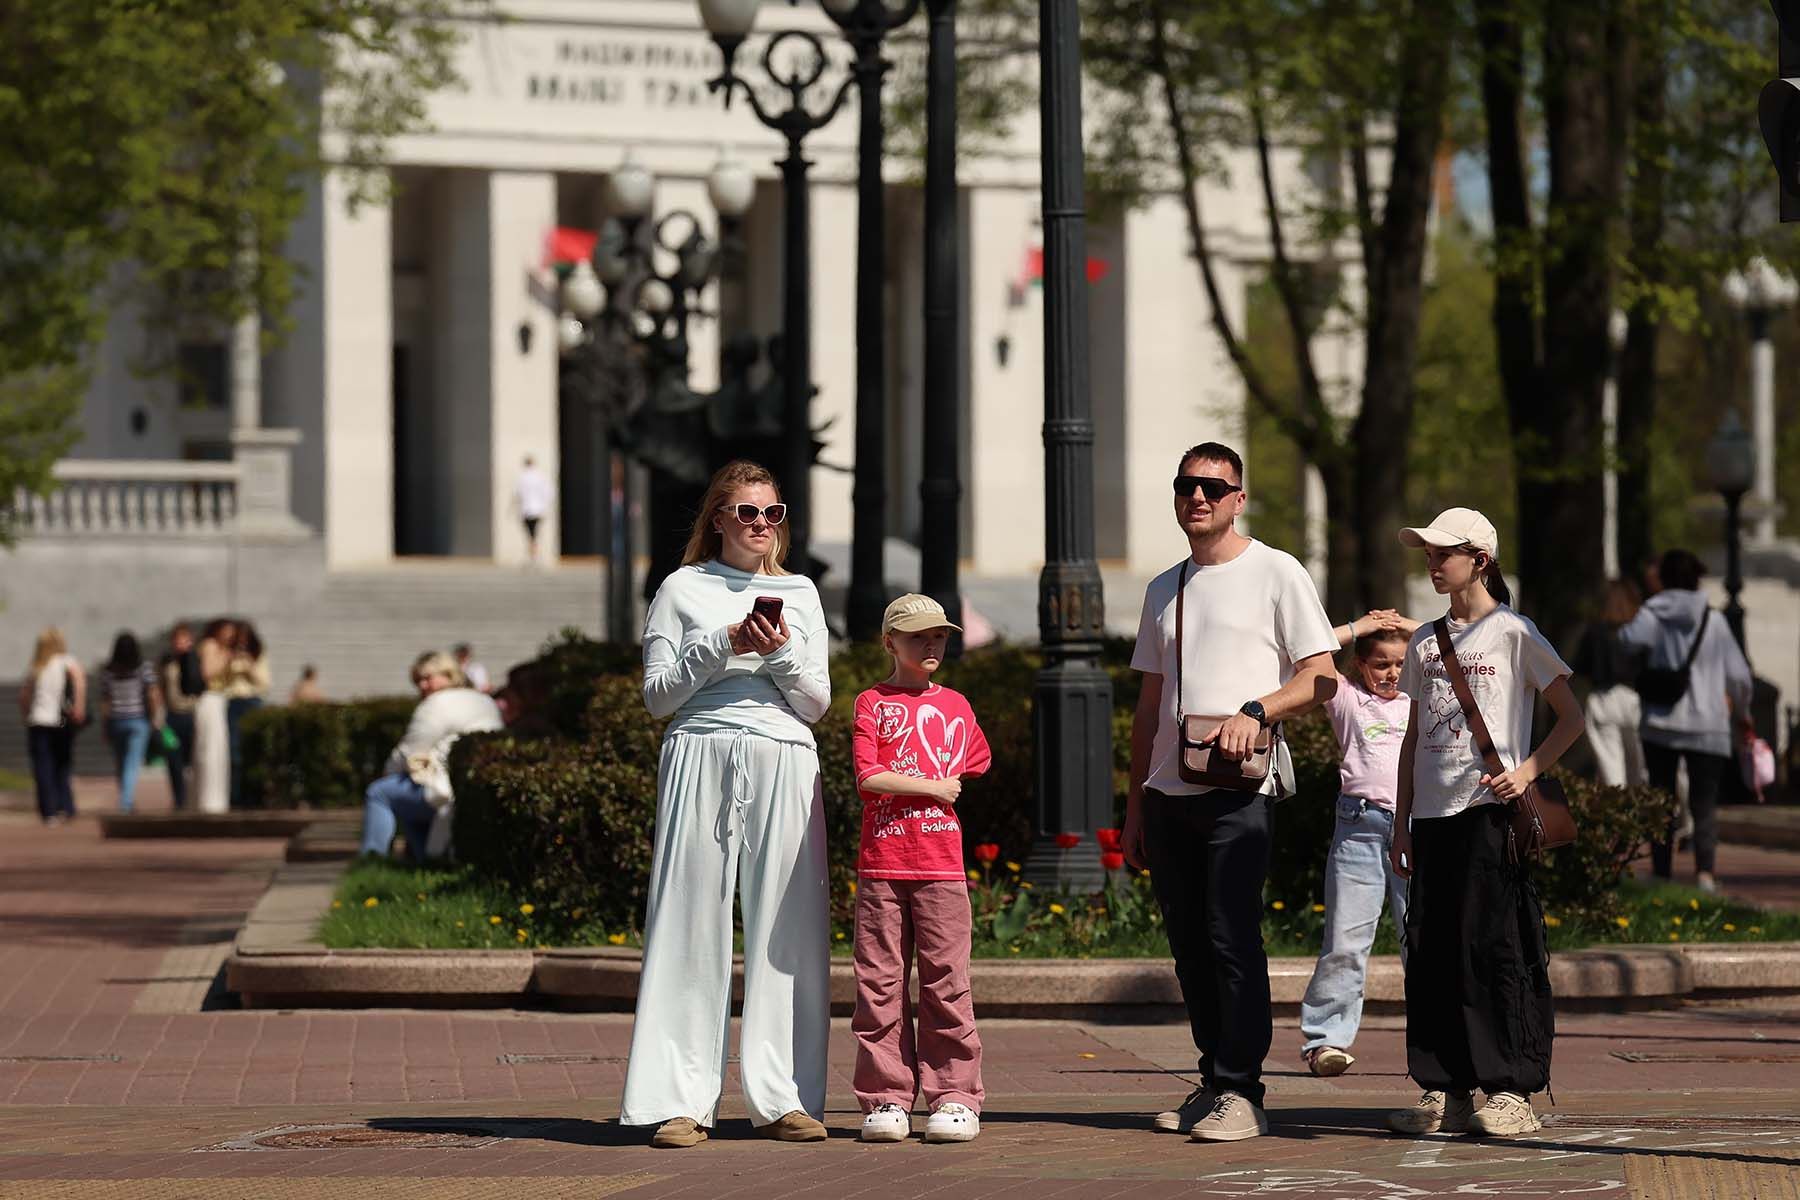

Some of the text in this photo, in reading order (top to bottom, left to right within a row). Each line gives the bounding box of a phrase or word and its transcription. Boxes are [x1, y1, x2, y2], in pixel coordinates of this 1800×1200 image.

[1425, 652, 1441, 663] Ba
[1461, 662, 1496, 676] ories
[873, 823, 906, 838] Usual
